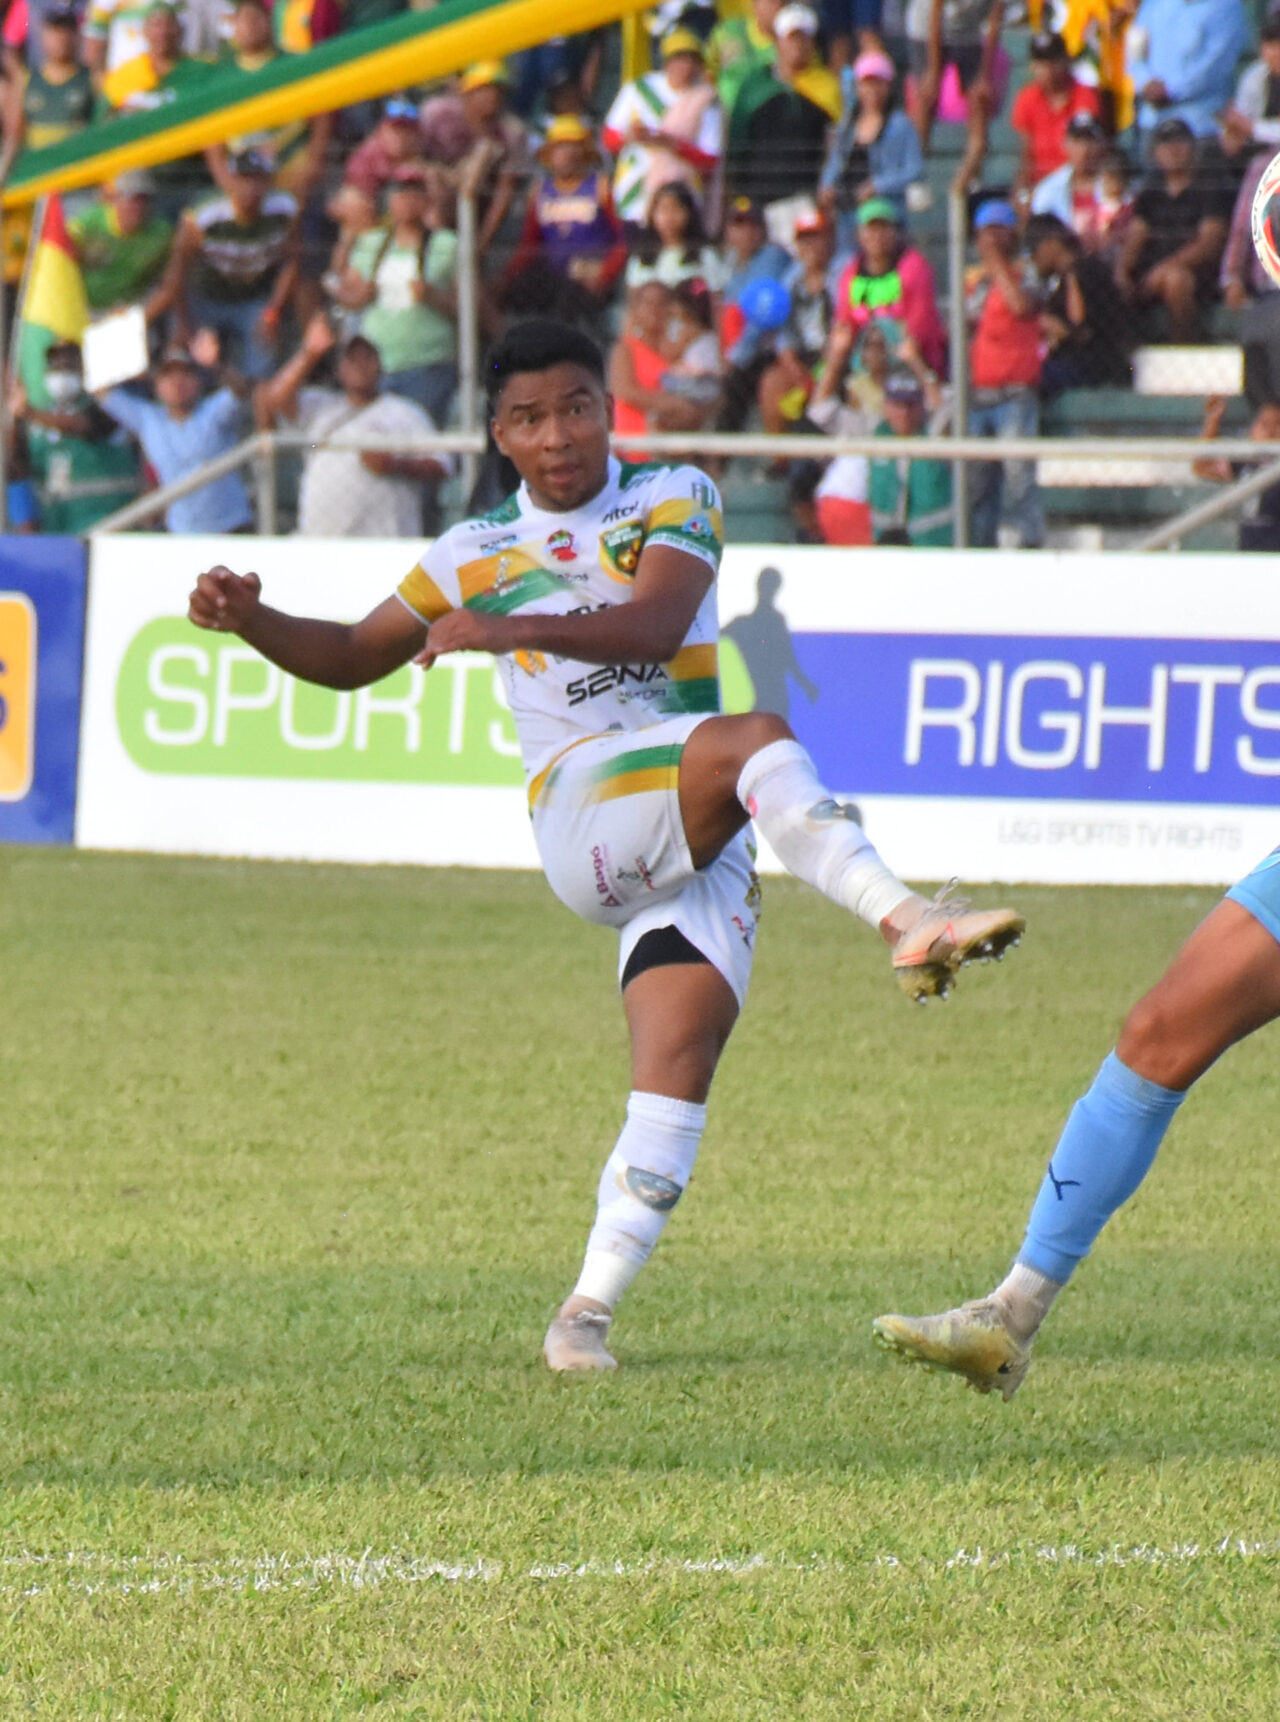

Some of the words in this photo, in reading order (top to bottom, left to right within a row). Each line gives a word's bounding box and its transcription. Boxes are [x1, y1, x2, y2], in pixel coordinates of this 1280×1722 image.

[1046, 818, 1130, 847] SPORTS
[1136, 821, 1164, 849] TV
[1166, 822, 1244, 852] RIGHTS
